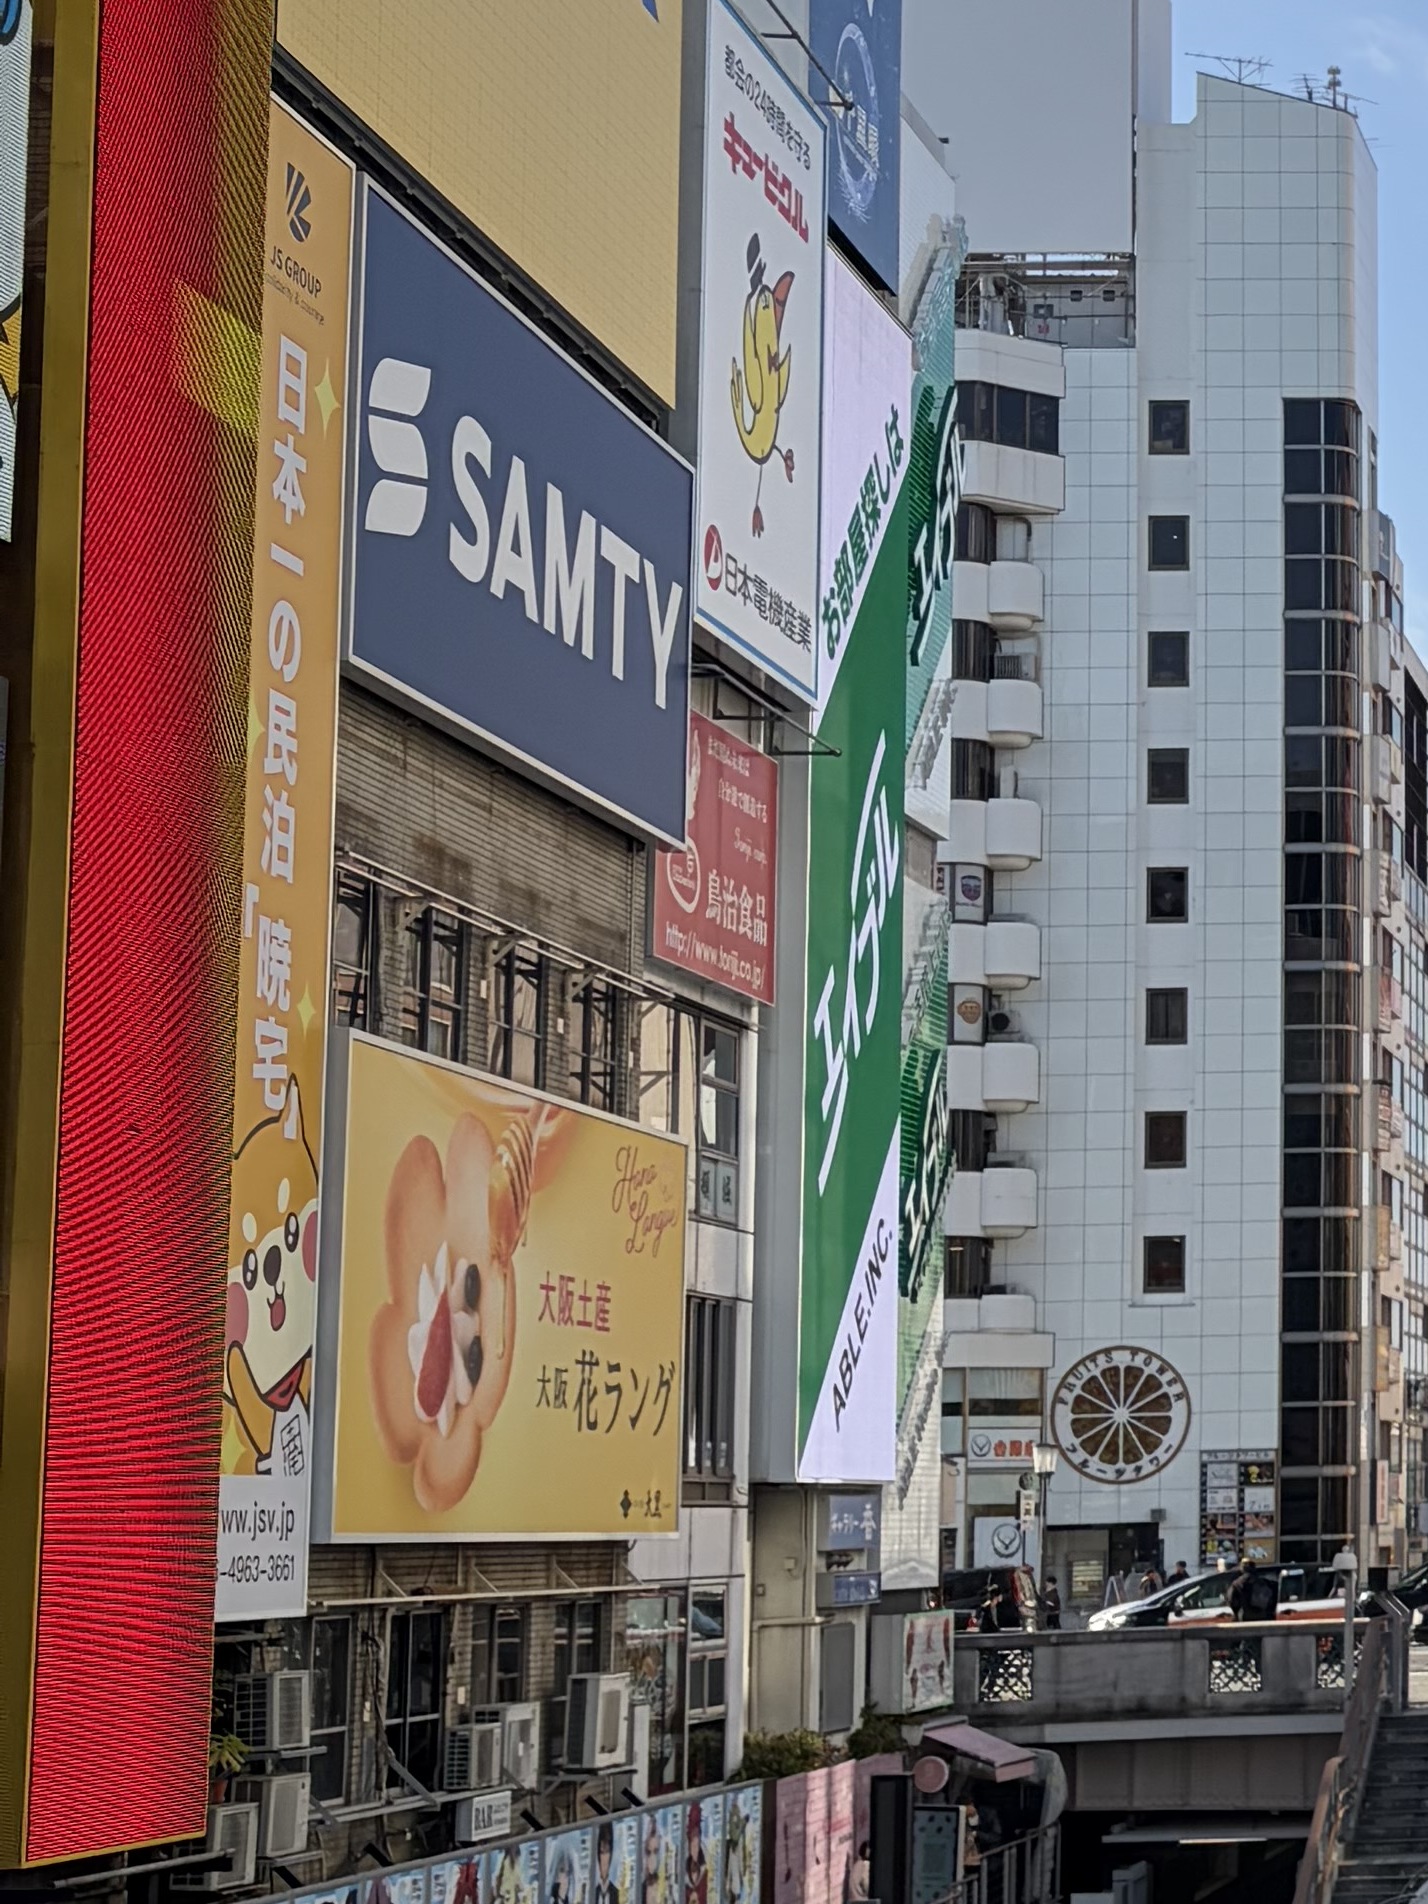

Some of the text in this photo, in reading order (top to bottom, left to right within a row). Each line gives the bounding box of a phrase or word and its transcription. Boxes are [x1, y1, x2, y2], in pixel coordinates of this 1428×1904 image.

[723, 111, 810, 243] キュービクル
[270, 245, 322, 299] JS GROUP
[449, 415, 684, 710] SAMTY
[822, 403, 905, 660] お部屋探しは
[724, 552, 812, 653] 日本電機産業
[813, 728, 899, 1197] エイブル
[538, 1271, 611, 1333] 大阪土産
[829, 1219, 894, 1433] ABLE.INC.
[1057, 1349, 1184, 1407] FRUITS TOWER
[1065, 1443, 1174, 1480] フルーツタワー
[219, 1501, 295, 1541] ww.jsv.jp
[217, 1553, 295, 1584] -4963-3661
[475, 1804, 492, 1830] BAR
